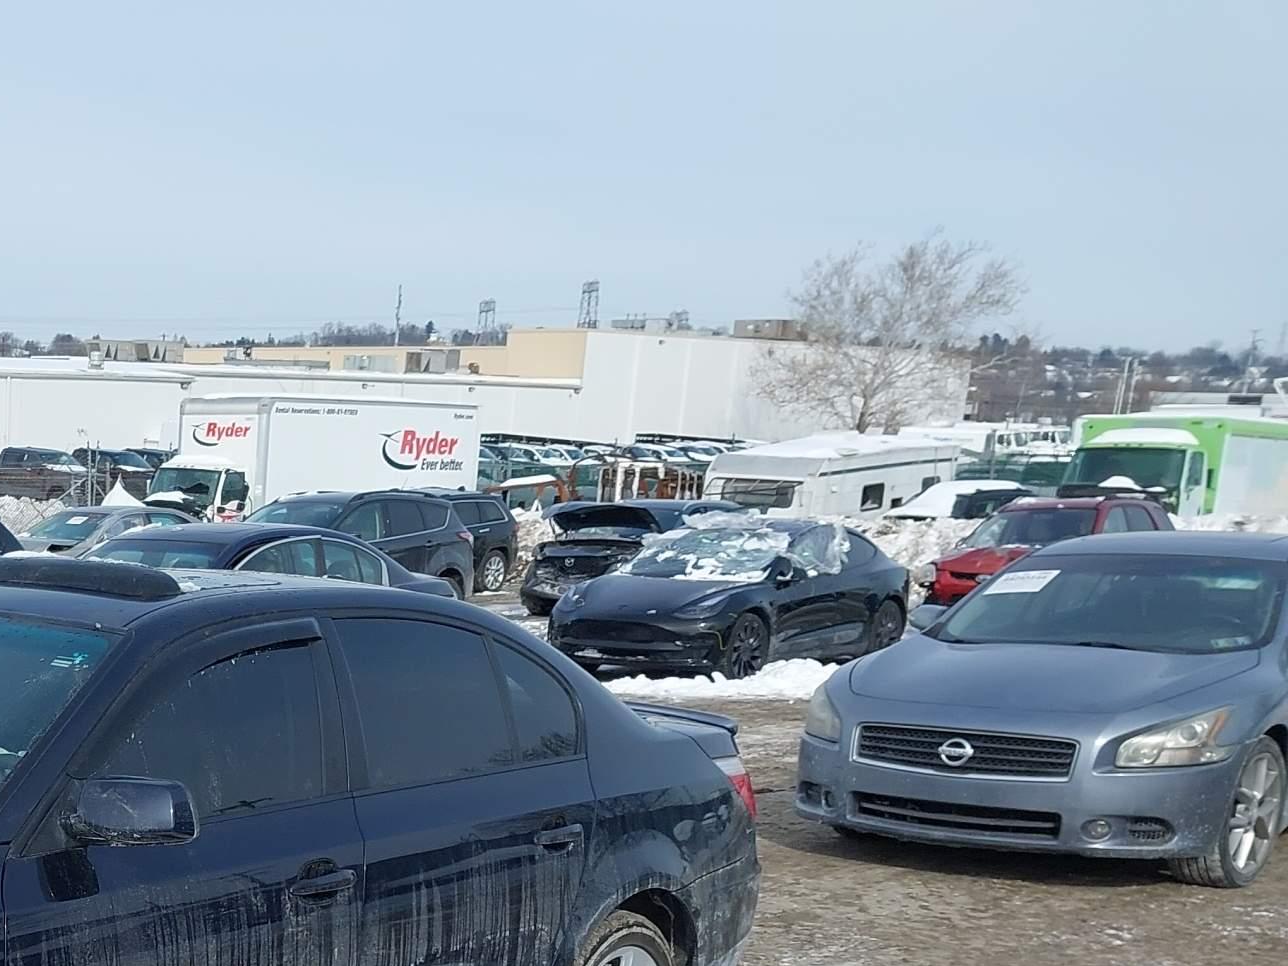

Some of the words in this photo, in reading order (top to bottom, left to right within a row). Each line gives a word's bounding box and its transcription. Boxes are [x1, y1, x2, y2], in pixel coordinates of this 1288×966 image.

[205, 422, 251, 441] Ryder
[400, 430, 458, 461] Ryder
[421, 458, 437, 471] Ever
